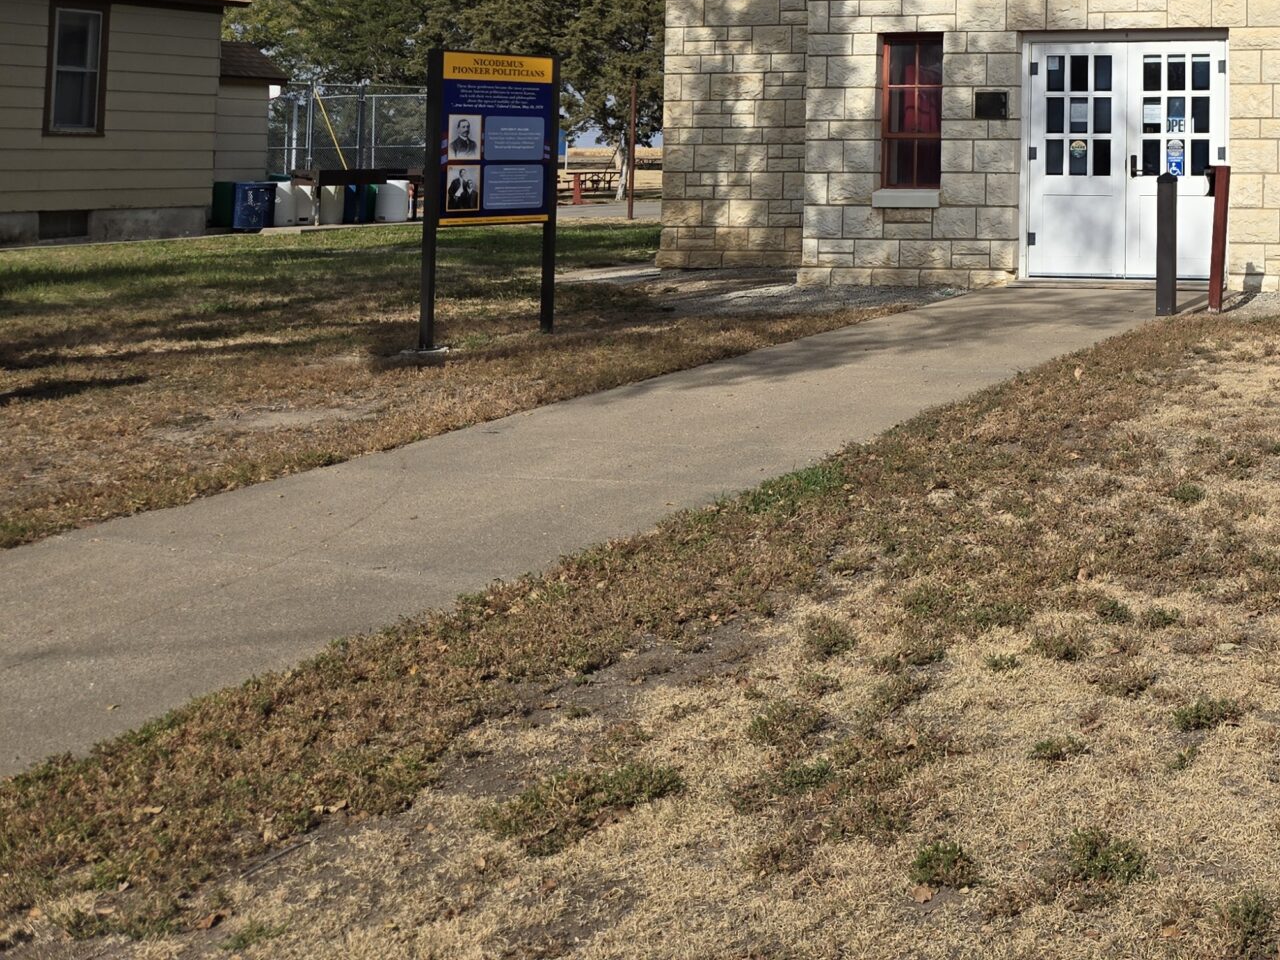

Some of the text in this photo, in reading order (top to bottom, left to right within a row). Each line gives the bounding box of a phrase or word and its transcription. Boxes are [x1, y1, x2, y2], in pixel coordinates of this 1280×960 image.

[473, 58, 525, 68] NICODEMUS
[452, 65, 545, 78] PIONEER POLITICIANS
